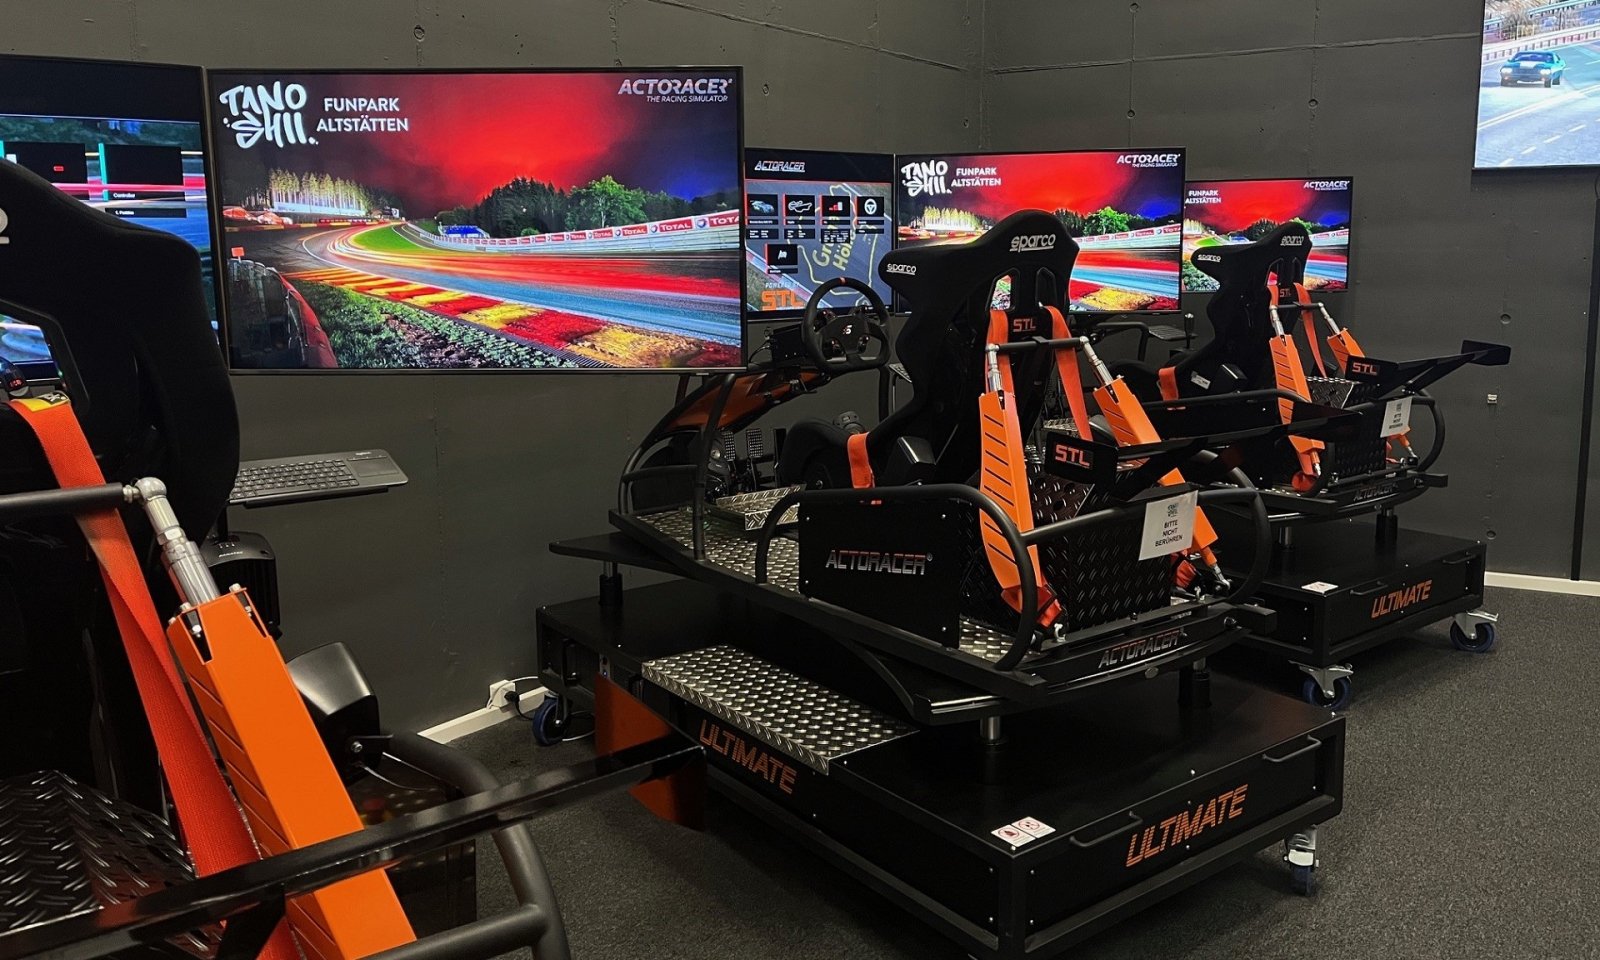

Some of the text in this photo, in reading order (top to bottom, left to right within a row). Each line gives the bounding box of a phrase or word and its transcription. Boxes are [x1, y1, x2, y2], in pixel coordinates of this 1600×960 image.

[219, 80, 307, 116] TANO
[324, 97, 400, 112] FUNPARK
[646, 95, 660, 103] THE
[661, 95, 687, 103] RACING
[316, 114, 409, 132] ALTSTÄTTEN
[754, 160, 806, 173] ACTORACER
[900, 159, 949, 180] TANO
[955, 167, 997, 177] FUNPARK
[950, 177, 1002, 187] ALTSTÄTTEN
[660, 223, 691, 231] TOTAL
[1009, 233, 1057, 253] sparco
[886, 263, 917, 276] sparco
[761, 290, 806, 311] STL
[1013, 318, 1037, 333] STL
[1352, 362, 1378, 376] STL
[1055, 444, 1090, 467] STL
[1164, 519, 1179, 529] BITTE
[1162, 527, 1179, 537] NICHT
[1155, 534, 1184, 547] BERÜHREN
[1370, 580, 1433, 618] ULTIMATE
[699, 718, 798, 796] ULTIMATE
[1125, 783, 1249, 868] ULTIMATE
